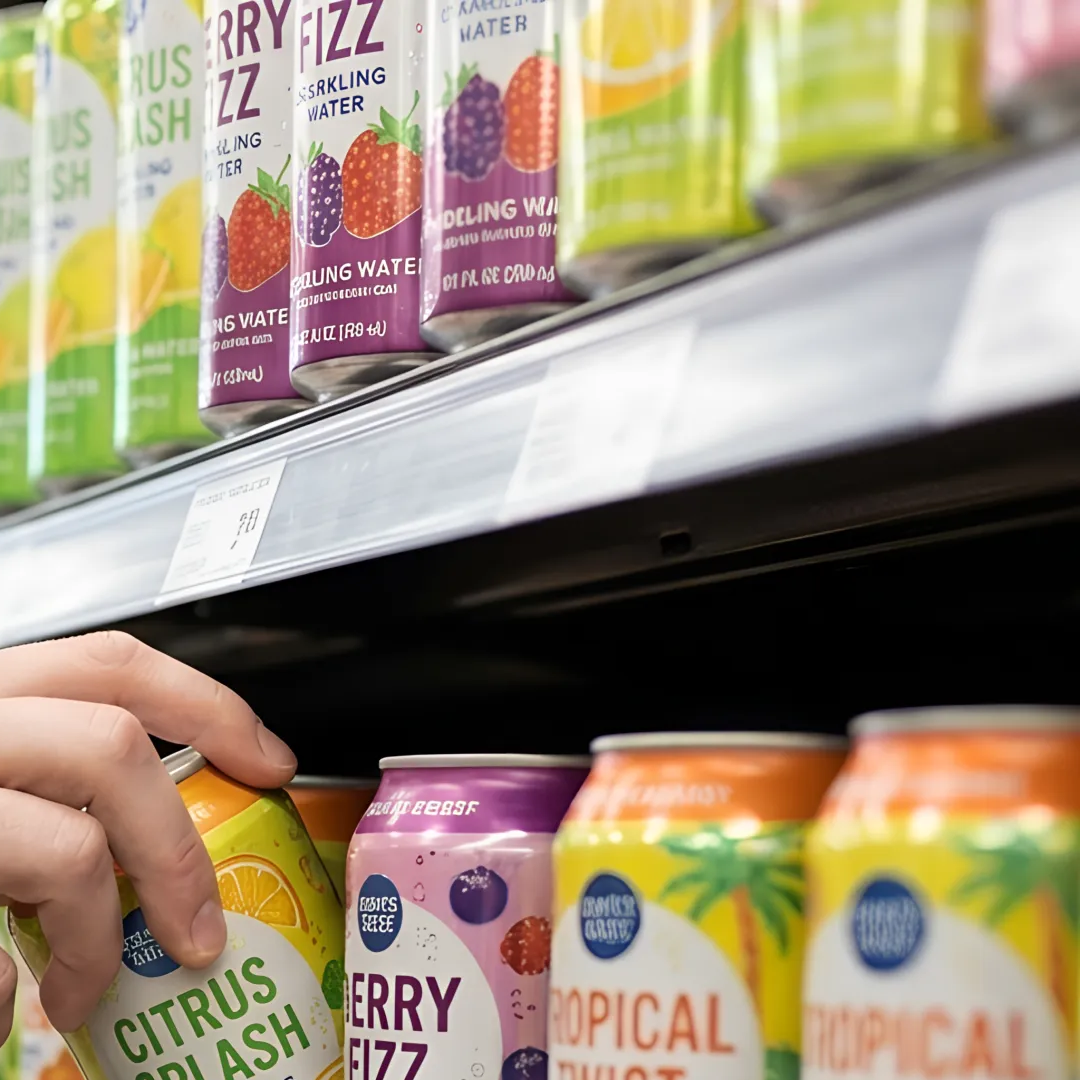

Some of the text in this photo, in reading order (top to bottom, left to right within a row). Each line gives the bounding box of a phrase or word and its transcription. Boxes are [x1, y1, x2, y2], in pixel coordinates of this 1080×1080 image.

[205, 0, 291, 66] RRY
[210, 63, 261, 130] ZZ
[307, 96, 364, 122] WATER
[358, 257, 421, 280] WATE
[113, 956, 278, 1064] CITRUS
[347, 972, 462, 1033] ERRY
